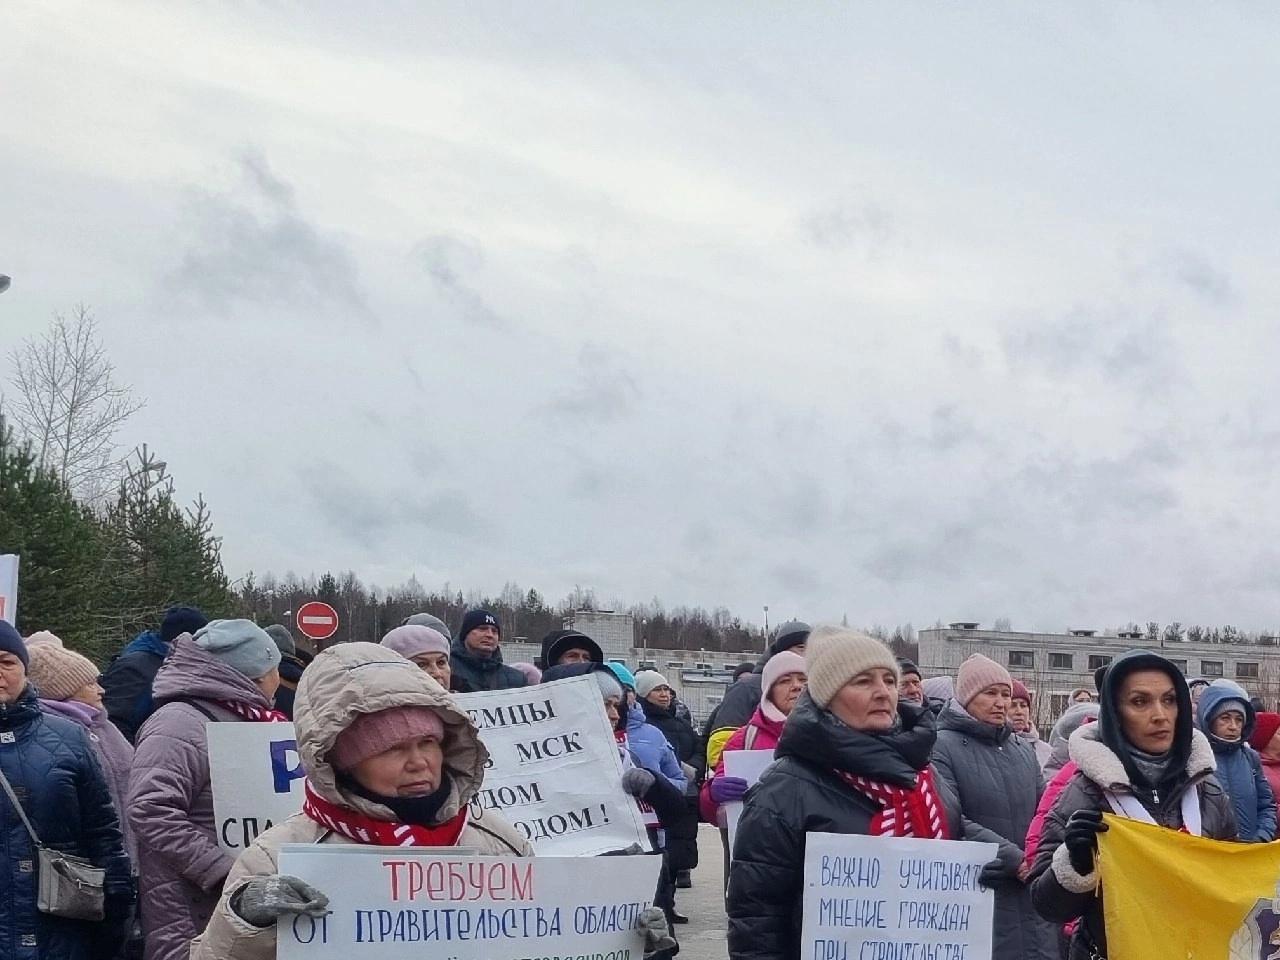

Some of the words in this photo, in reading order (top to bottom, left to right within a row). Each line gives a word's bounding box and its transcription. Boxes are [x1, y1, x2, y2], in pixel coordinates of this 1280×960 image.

[514, 732, 584, 764] МСК
[819, 898, 888, 929] МНЕНИЕ
[898, 900, 972, 932] ГРАЖДАН
